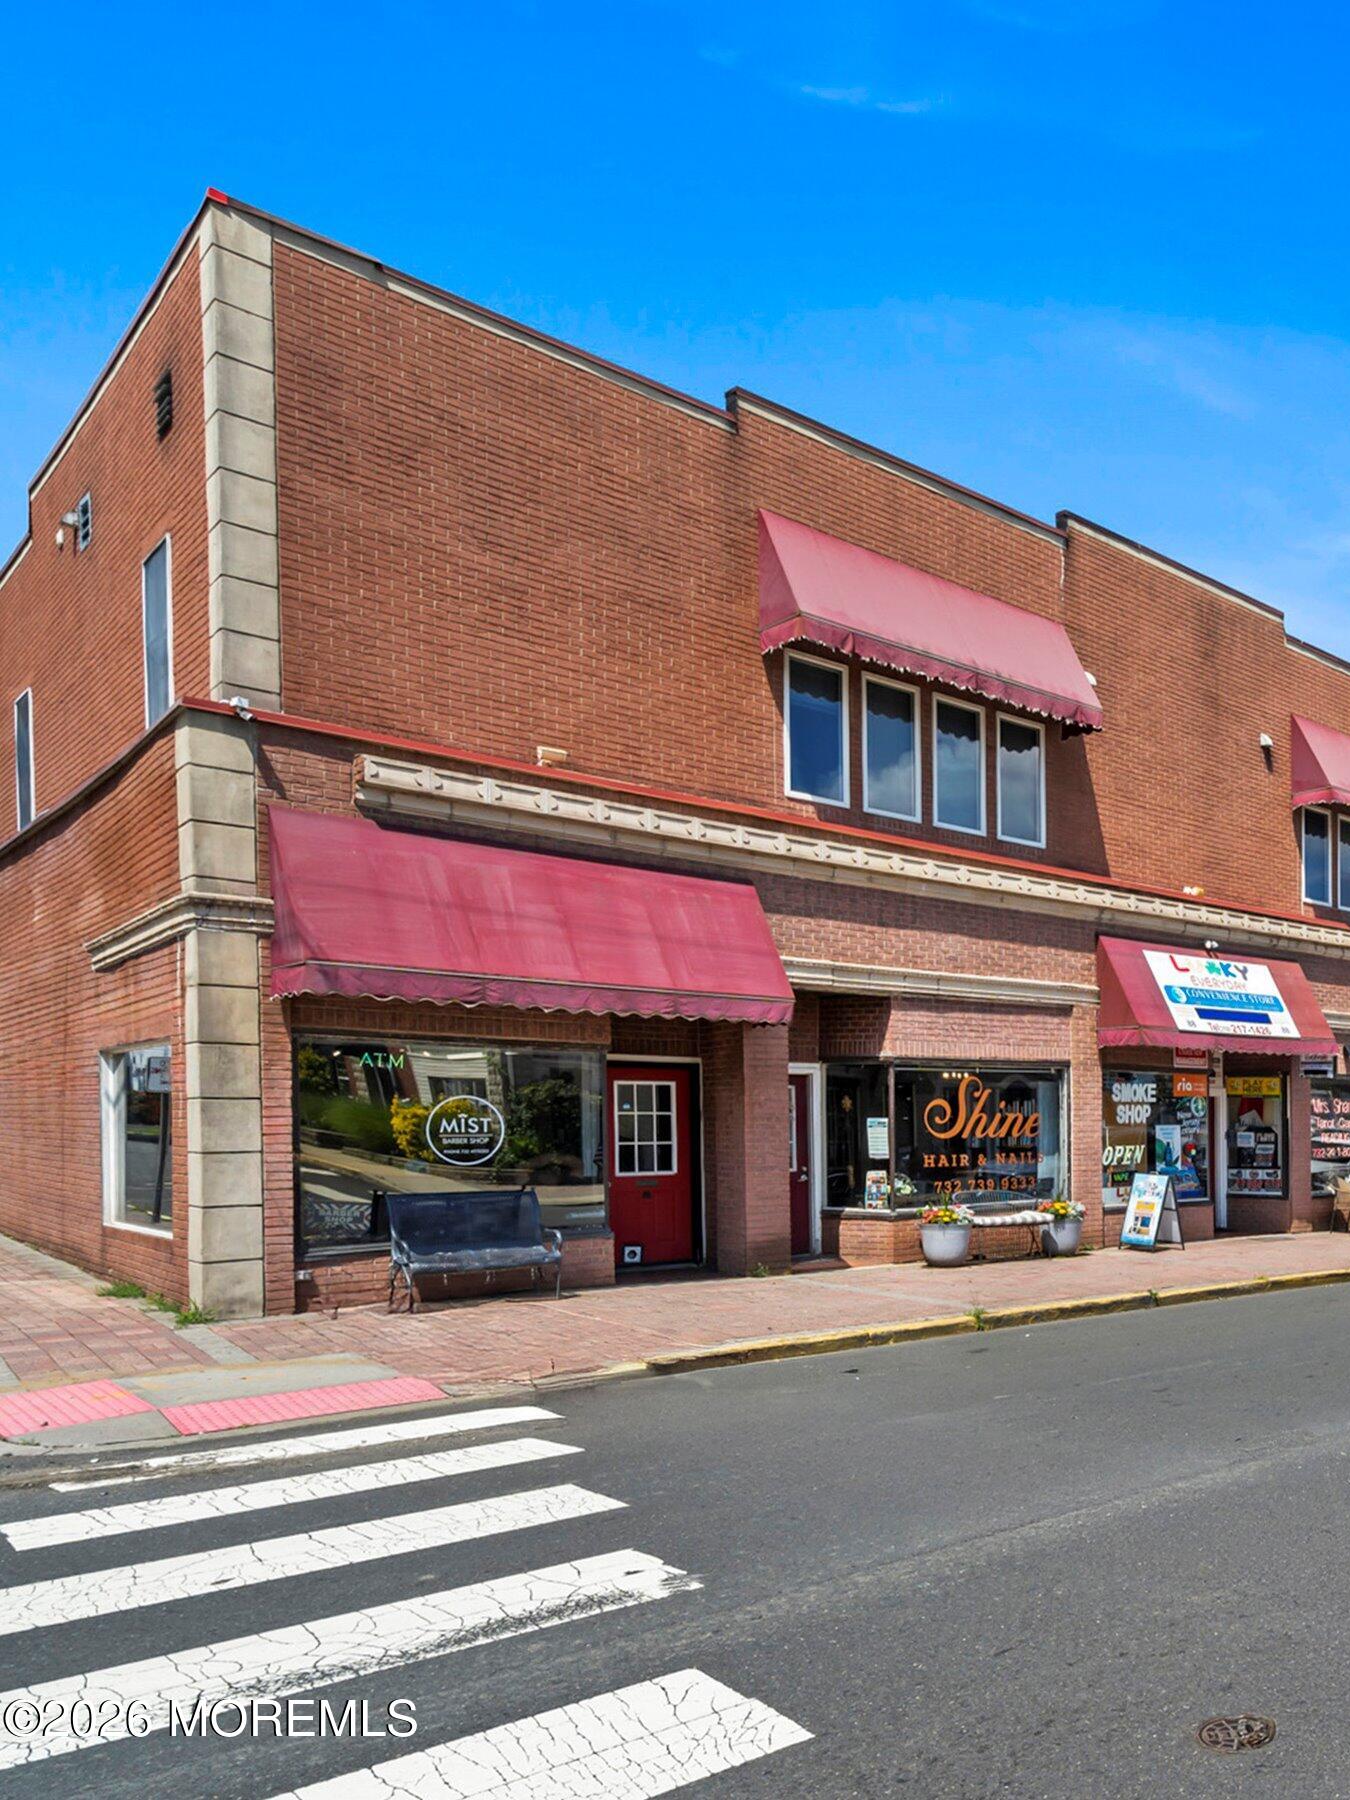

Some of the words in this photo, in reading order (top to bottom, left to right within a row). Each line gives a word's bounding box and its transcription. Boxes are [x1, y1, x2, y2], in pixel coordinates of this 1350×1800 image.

[1169, 954, 1249, 981] LKY
[1186, 988, 1247, 1003] CONVENIENCE
[1249, 993, 1276, 1005] STORE
[360, 1052, 405, 1069] ATM
[1112, 1083, 1157, 1102] SMOKE
[924, 1075, 1041, 1139] Shine
[1116, 1104, 1151, 1124] SHOP
[440, 1117, 491, 1133] MIST
[923, 1154, 969, 1168] HAIR
[978, 1154, 987, 1167] &
[995, 1152, 1044, 1165] NAILS
[1103, 1145, 1145, 1166] OPEN
[934, 1180, 961, 1194] 732
[968, 1179, 995, 1191] 739
